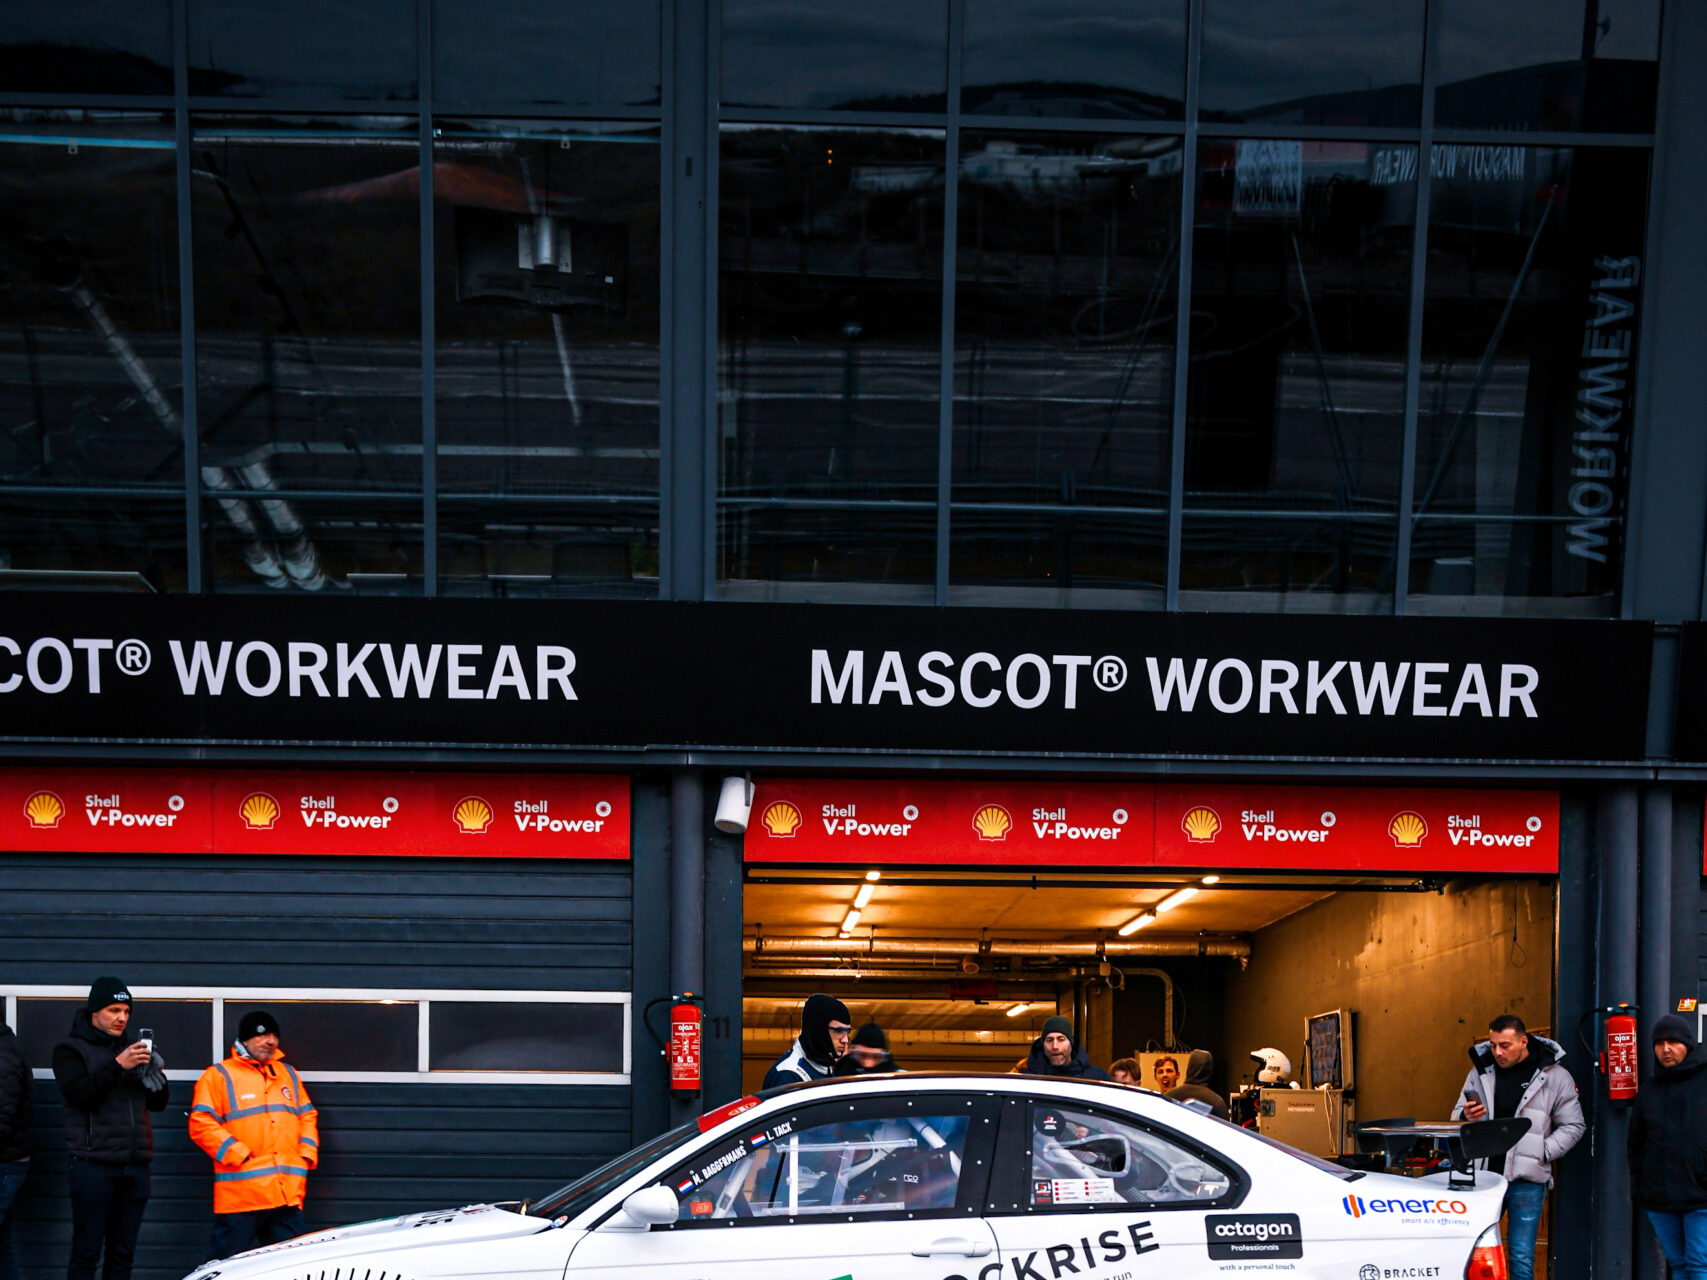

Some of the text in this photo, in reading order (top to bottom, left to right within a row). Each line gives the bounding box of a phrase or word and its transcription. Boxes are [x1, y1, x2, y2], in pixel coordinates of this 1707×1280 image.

[168, 640, 579, 701] WORKWEAR
[811, 649, 1539, 718] MASCOT® WORKWEAR
[85, 794, 120, 808] Shell
[300, 796, 335, 809] Shell
[514, 800, 548, 813] Shell
[85, 808, 178, 828] V-Power
[300, 809, 392, 829] V-Power
[822, 804, 856, 817] Shell
[1032, 807, 1066, 821] Shell
[1241, 810, 1274, 823] Shell
[514, 814, 605, 833] V-Power
[822, 817, 912, 837] V-Power
[1447, 814, 1480, 828] Shell
[1032, 822, 1122, 840] V-Power
[1241, 824, 1330, 843] V-Power
[1447, 828, 1536, 847] V-Power
[678, 1023, 694, 1032] ajax
[712, 1016, 731, 1039] 11
[765, 1121, 793, 1141] L. TACX
[691, 1173, 704, 1186] M.
[1369, 1198, 1468, 1215] ener.co
[1215, 1221, 1294, 1241] octagon
[1231, 1243, 1280, 1252] Professionals
[1219, 1263, 1236, 1271] with
[1243, 1263, 1274, 1272] personal
[1275, 1262, 1296, 1271] touch
[1384, 1266, 1441, 1279] BRACKET
